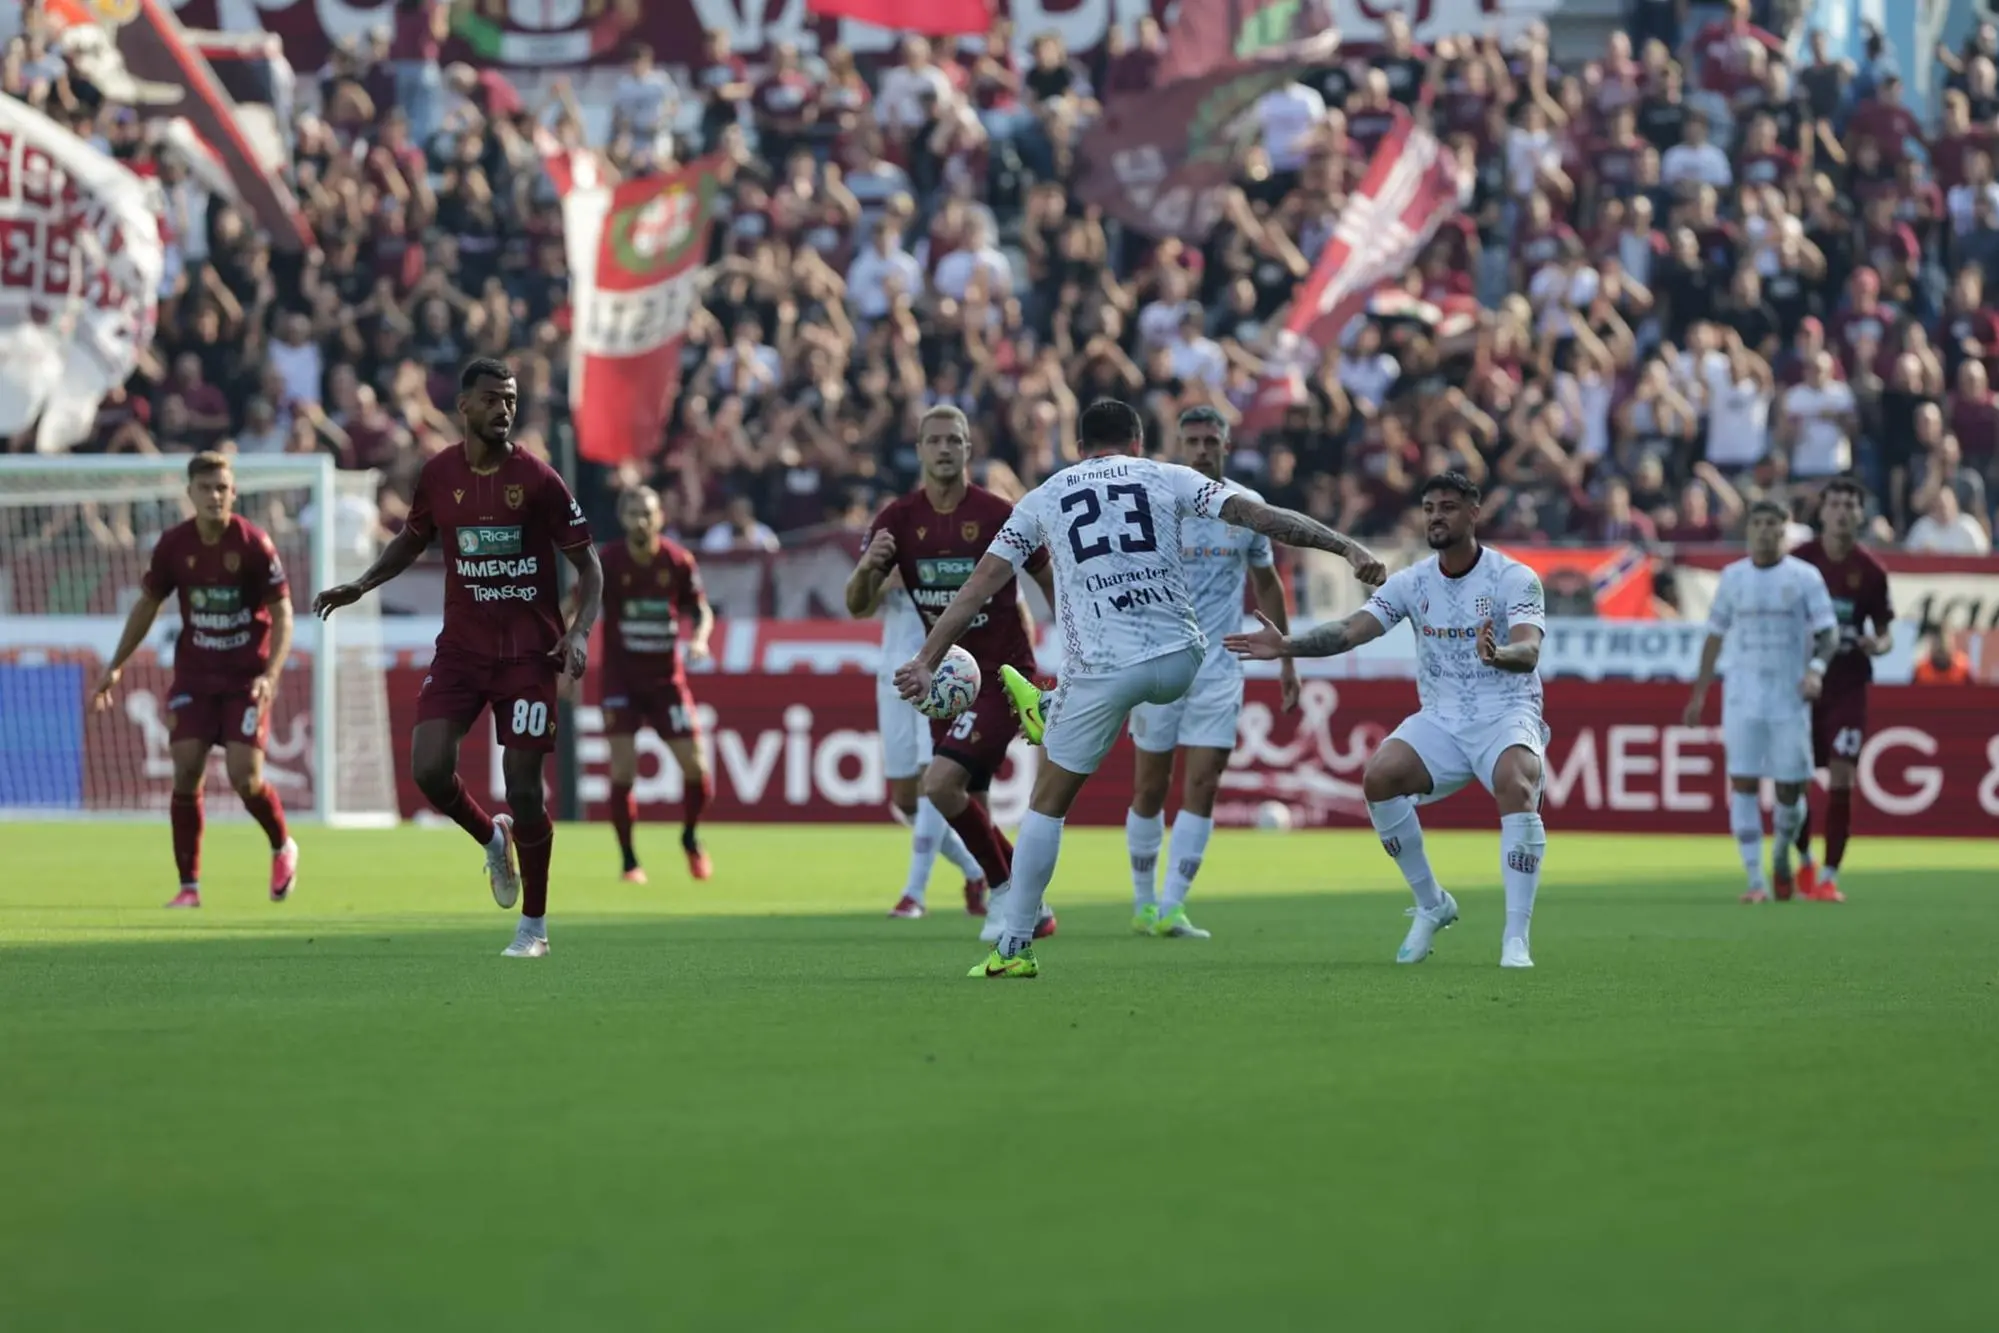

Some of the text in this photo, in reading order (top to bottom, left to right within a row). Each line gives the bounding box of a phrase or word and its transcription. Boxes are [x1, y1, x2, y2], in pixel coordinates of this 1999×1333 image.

[1060, 483, 1157, 564] 23
[1086, 566, 1170, 593] Character
[511, 699, 549, 737] 80
